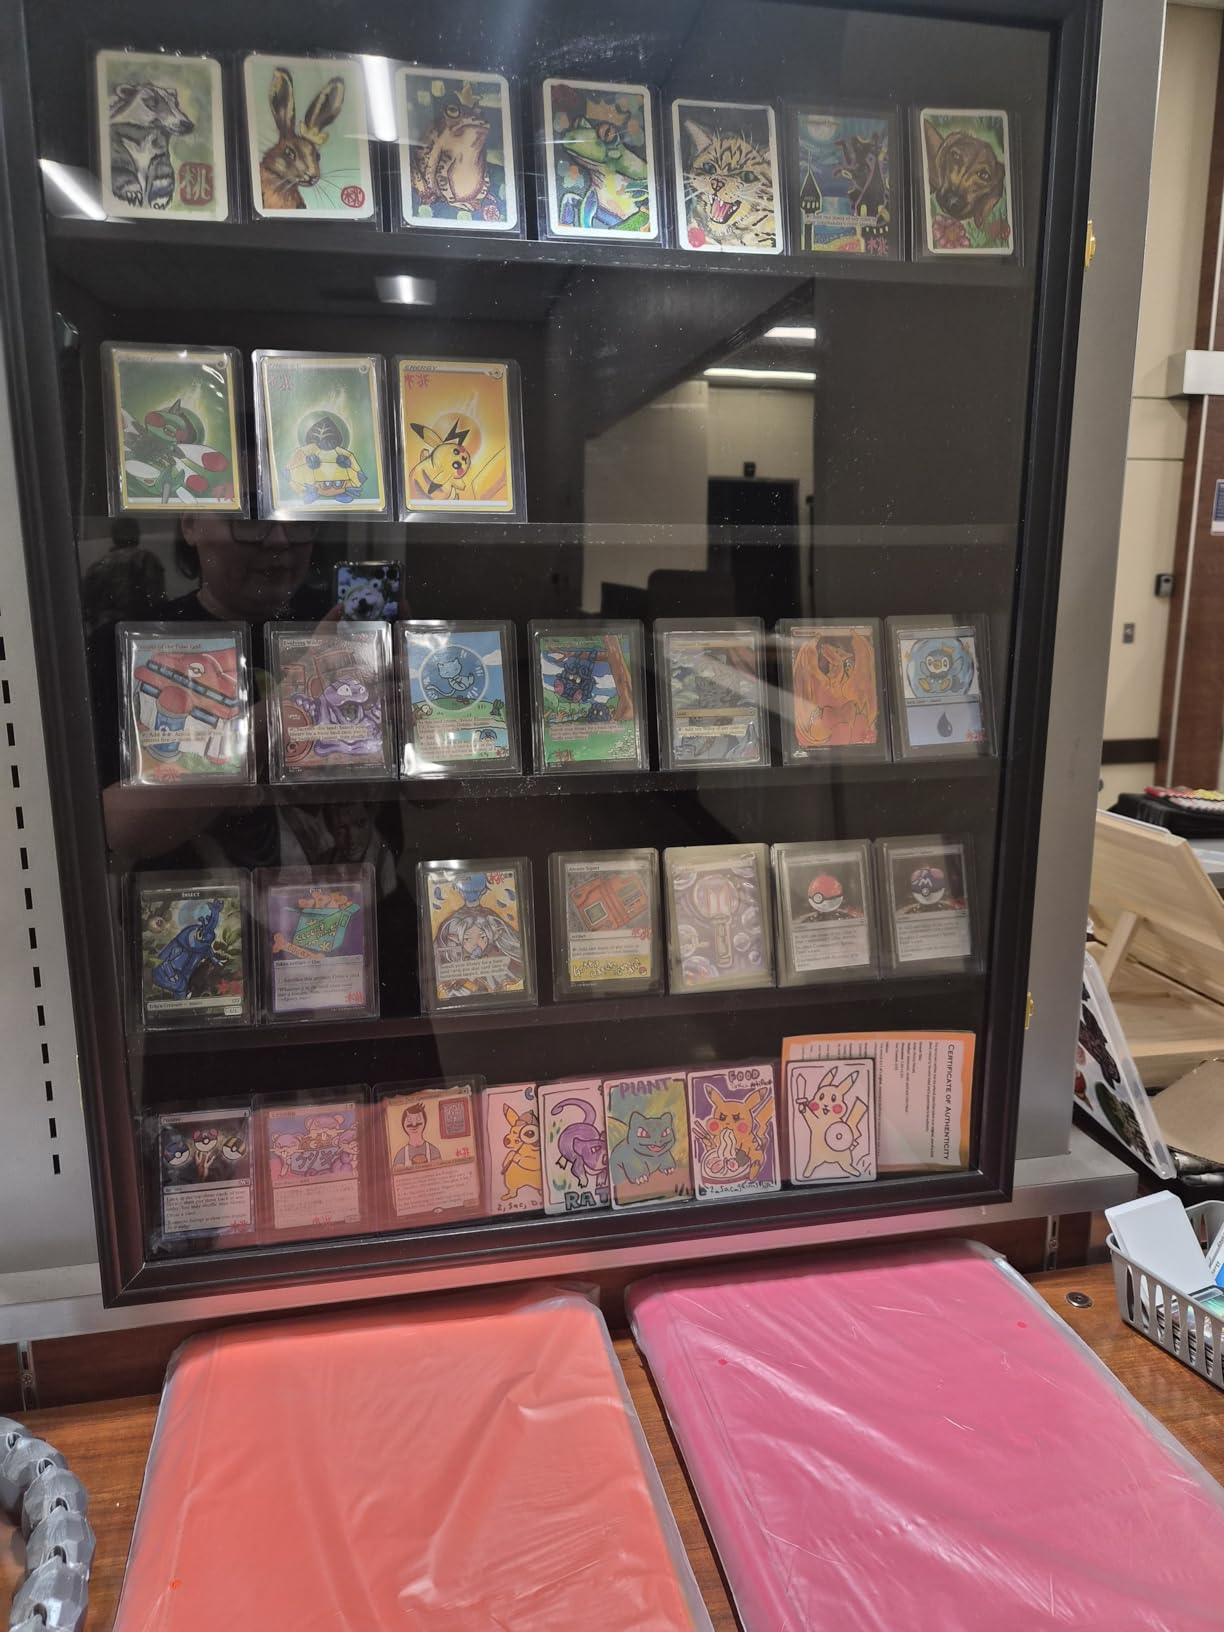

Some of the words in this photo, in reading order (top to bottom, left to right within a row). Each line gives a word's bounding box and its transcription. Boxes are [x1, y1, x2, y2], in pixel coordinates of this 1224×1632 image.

[945, 1044, 955, 1093] CERTIFICATE
[945, 1094, 952, 1104] OF
[943, 1106, 952, 1160] AUTHENTICITY
[564, 1187, 610, 1211] RAT
